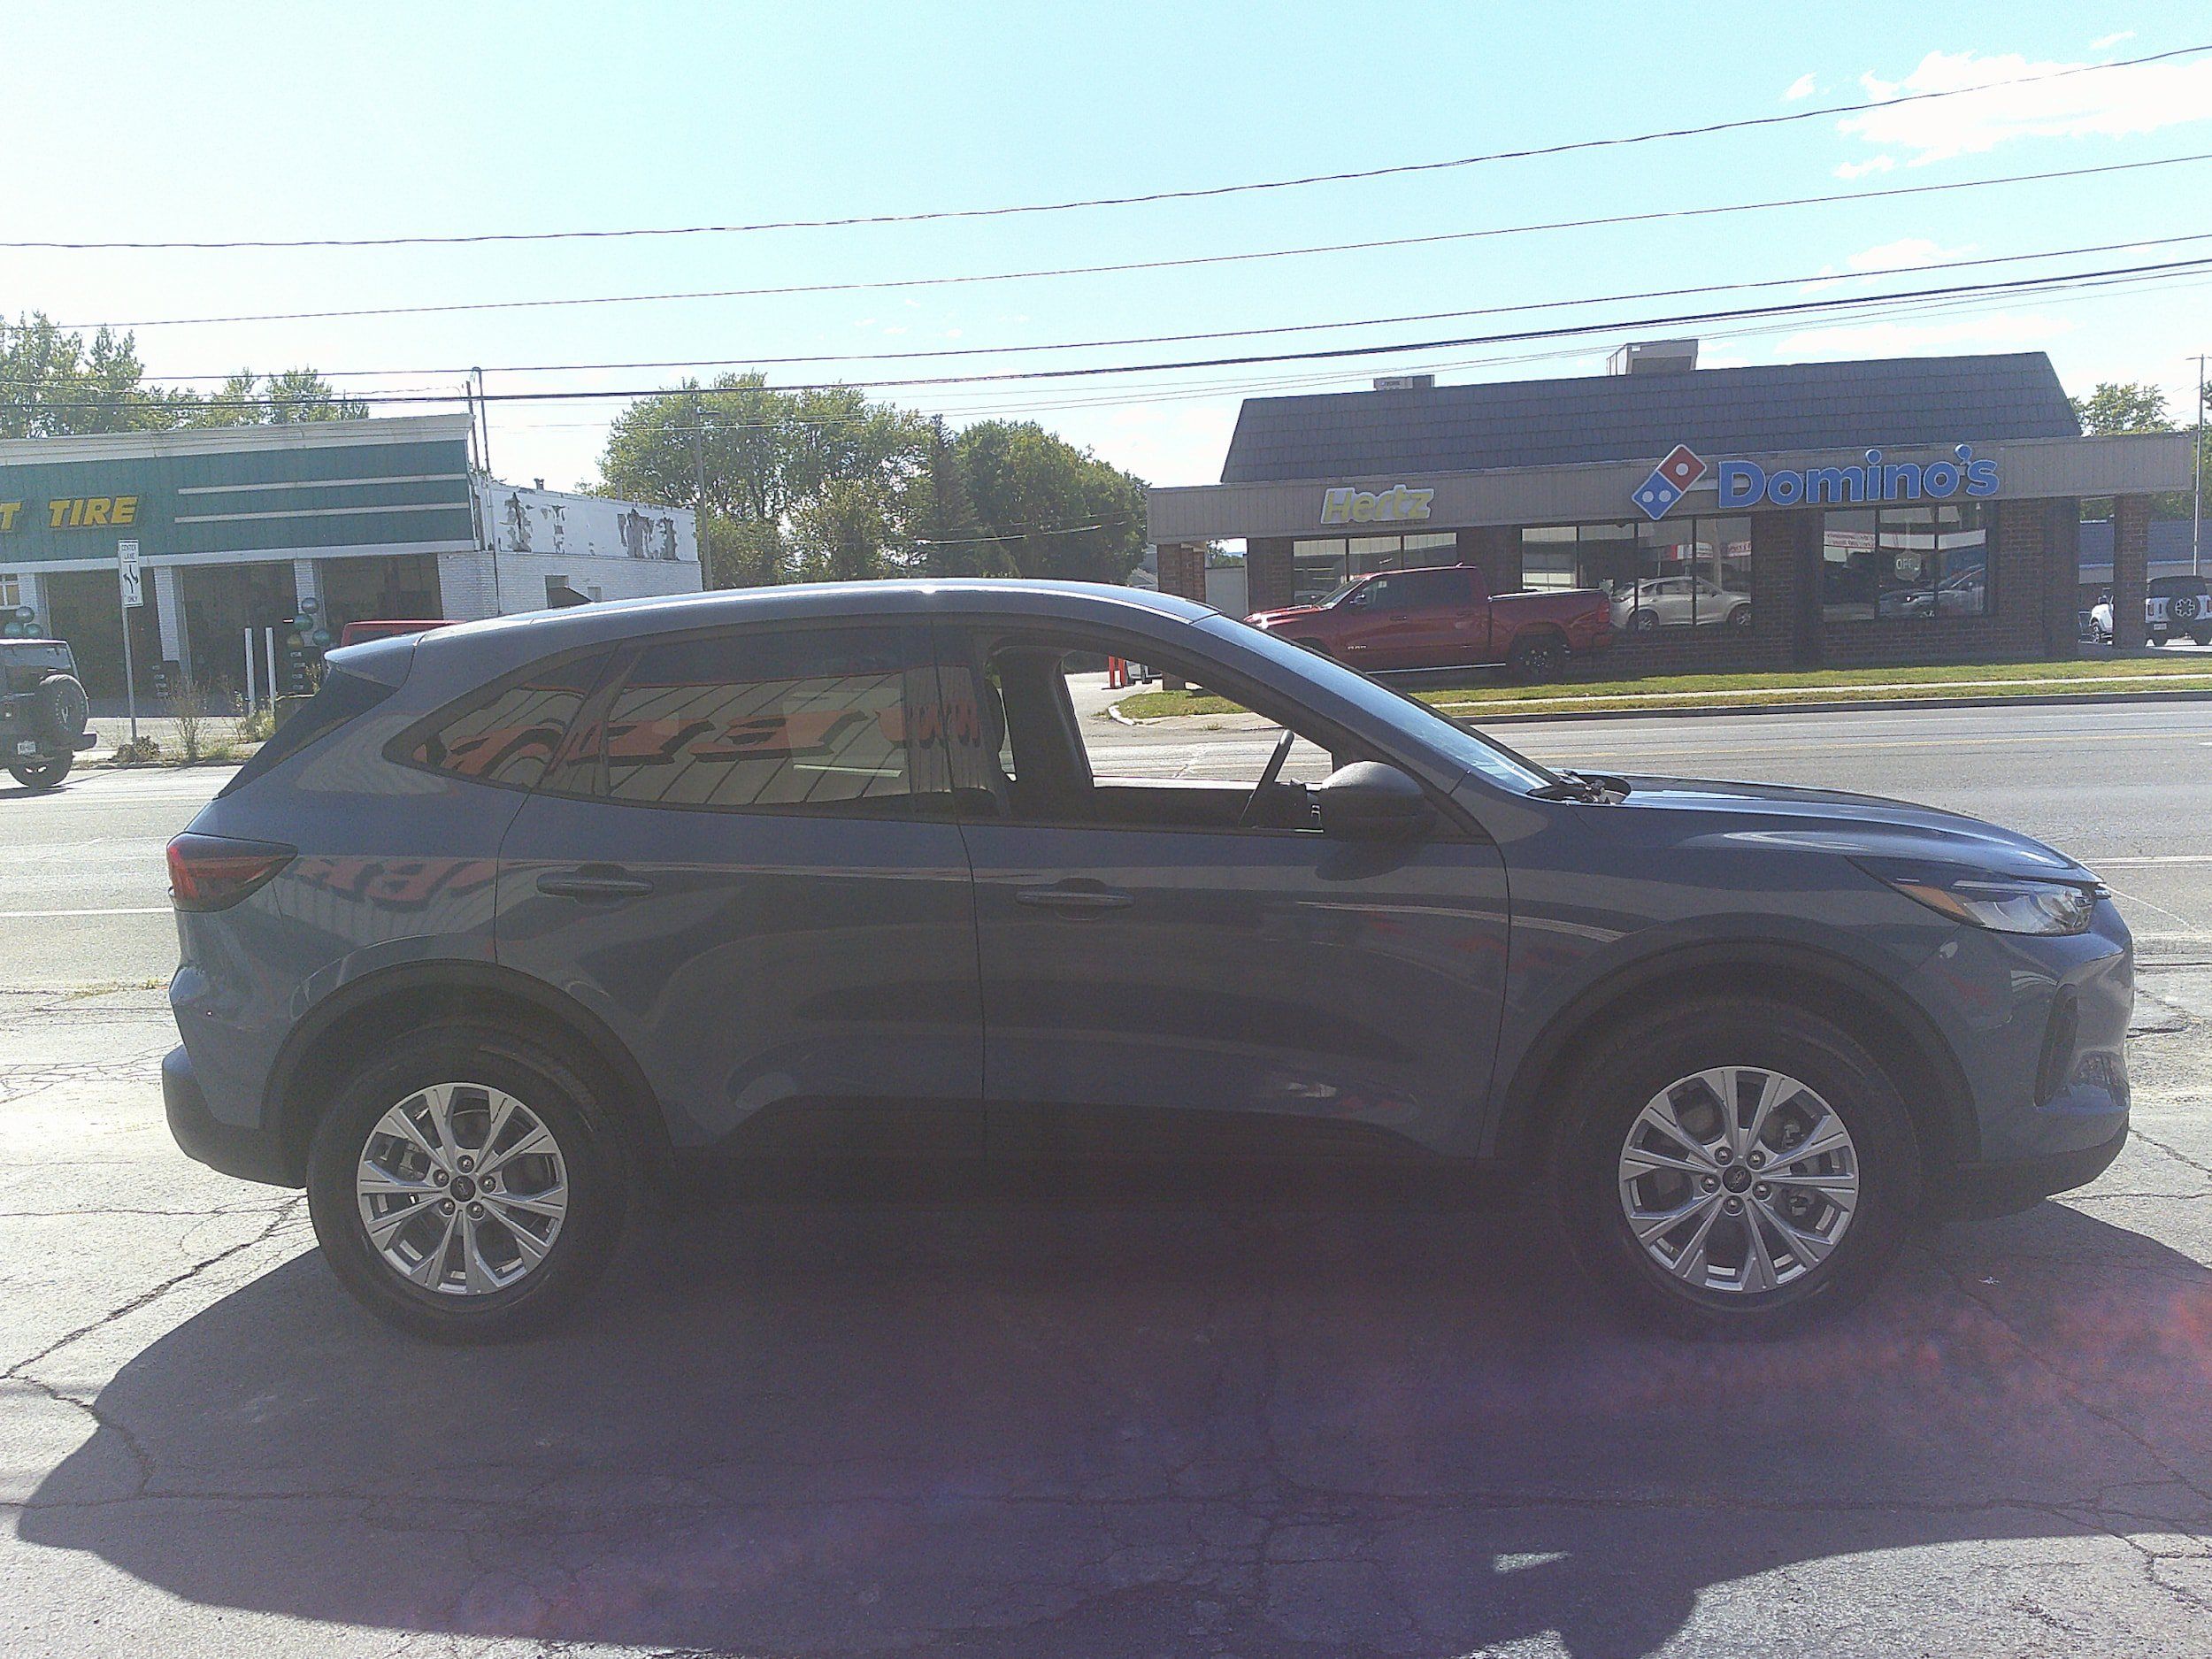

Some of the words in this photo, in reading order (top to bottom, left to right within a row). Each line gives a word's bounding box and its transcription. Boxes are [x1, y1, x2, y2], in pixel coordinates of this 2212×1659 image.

[1718, 443, 2000, 509] Domino's
[49, 496, 138, 528] TIRE
[1323, 487, 1432, 522] Hertz
